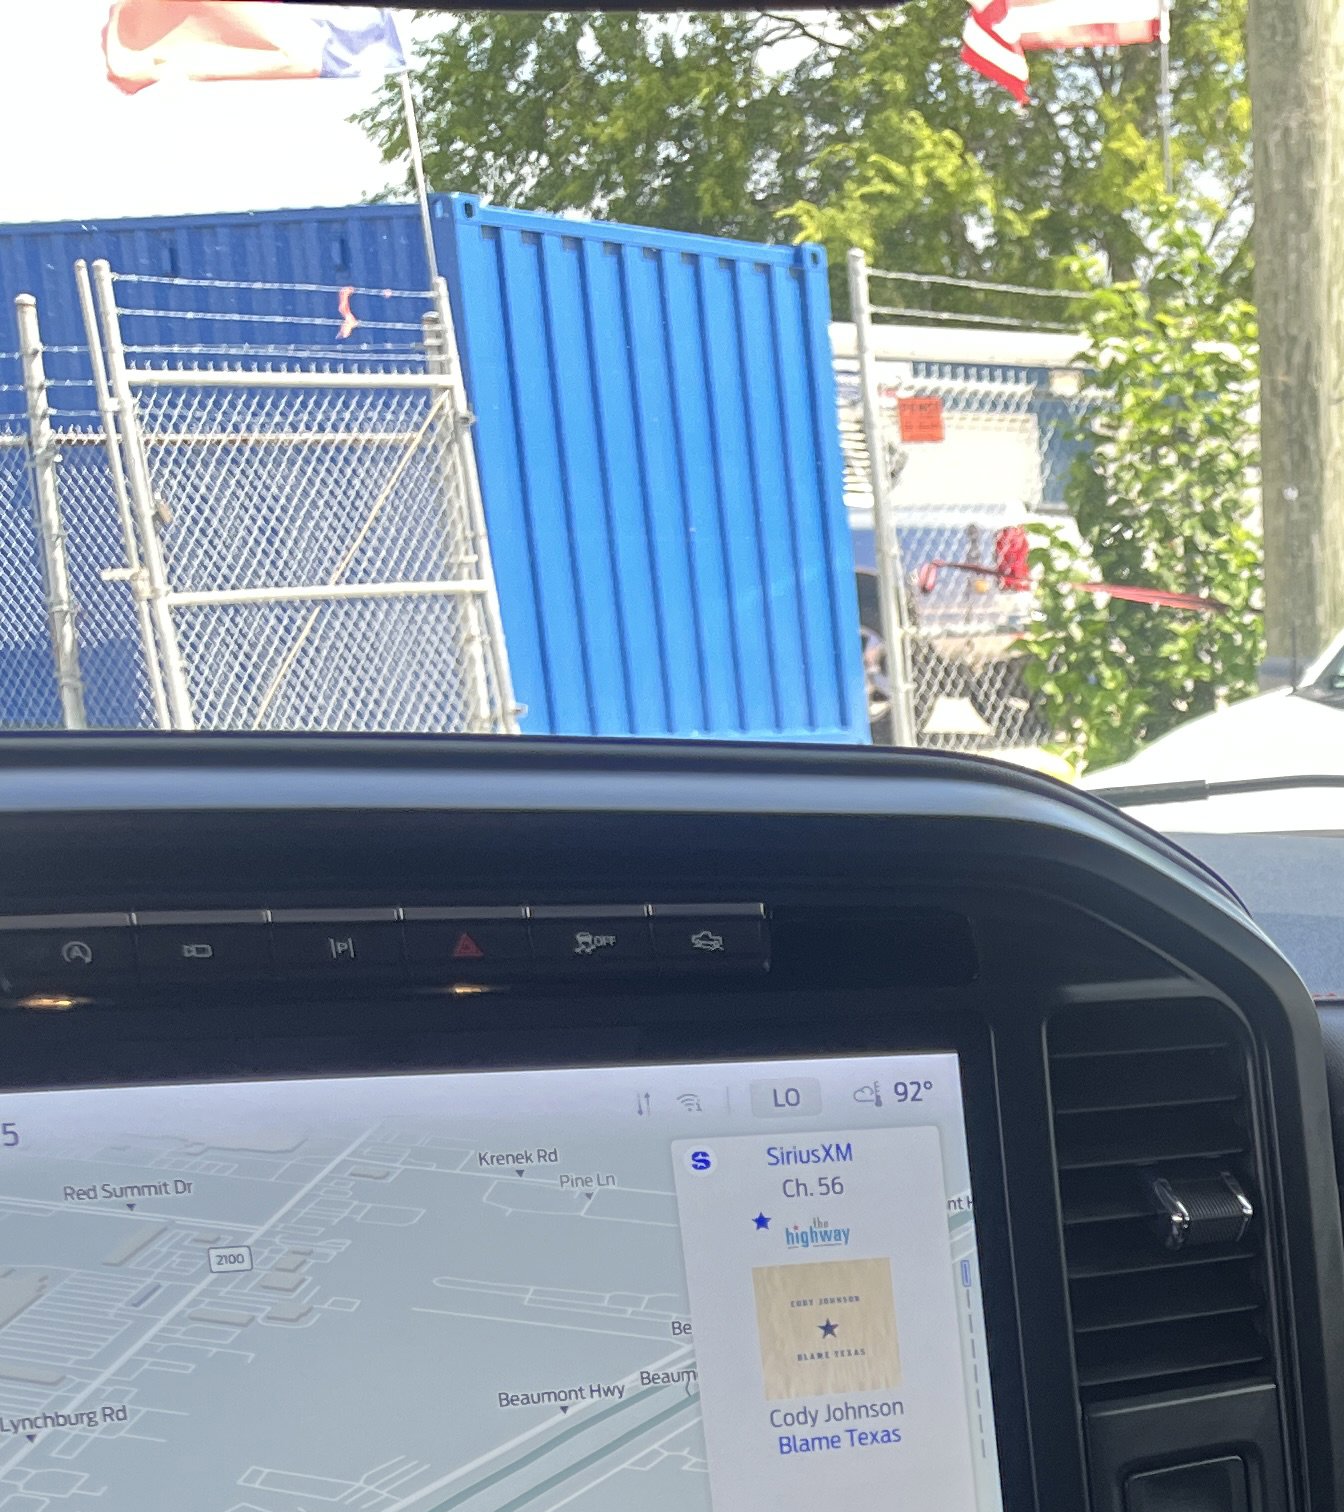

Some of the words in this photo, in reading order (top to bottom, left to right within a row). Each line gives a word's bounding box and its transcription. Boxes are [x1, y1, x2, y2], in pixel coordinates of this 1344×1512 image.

[772, 1087, 801, 1107] LO
[478, 1149, 534, 1166] Krenek
[536, 1147, 559, 1163] Rd
[767, 1142, 854, 1166] SiriusXM
[63, 1184, 98, 1201] Red
[101, 1181, 171, 1199] Summit
[174, 1179, 193, 1195] Dr
[559, 1173, 594, 1188] Pine
[596, 1173, 616, 1187] Ln
[782, 1177, 815, 1198] Ch.
[818, 1175, 845, 1196] 56
[784, 1223, 851, 1249] highway
[215, 1253, 245, 1266] 2100
[640, 1369, 698, 1386] Beaum
[498, 1385, 586, 1408] Beaumont
[588, 1383, 626, 1399] Hwy
[0, 1411, 99, 1435] Lynchburg
[101, 1404, 128, 1423] Rd
[769, 1405, 819, 1429] Cody
[824, 1400, 905, 1423] Johnson
[777, 1433, 842, 1455] Blame
[844, 1427, 902, 1447] Texas
